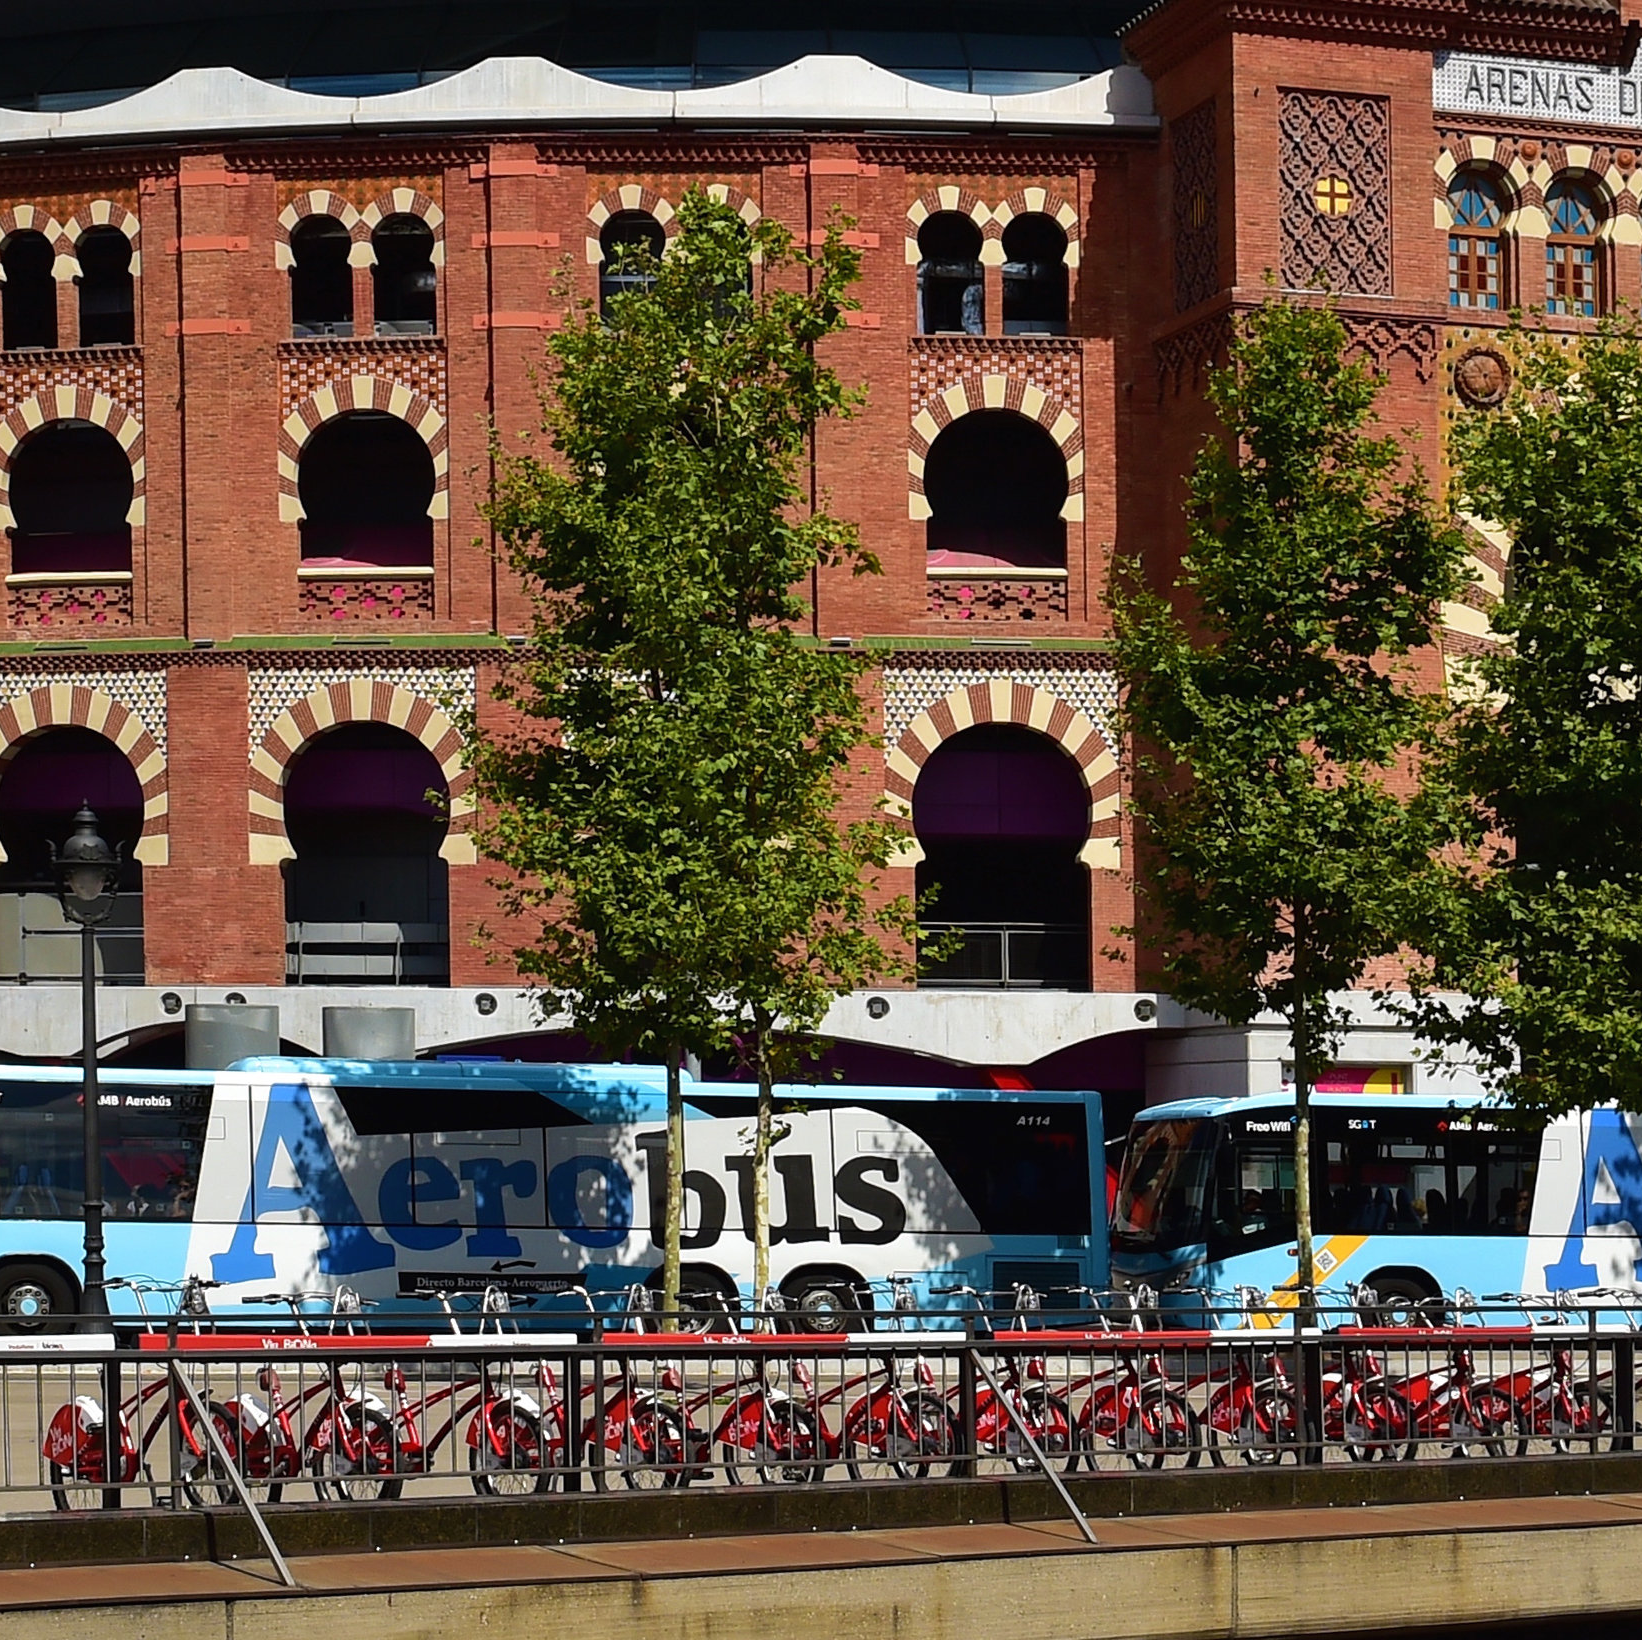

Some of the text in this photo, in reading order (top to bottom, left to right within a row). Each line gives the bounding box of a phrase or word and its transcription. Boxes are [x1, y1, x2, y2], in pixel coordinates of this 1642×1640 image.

[1463, 64, 1595, 113] ARENAS
[125, 1094, 172, 1108] Aerobús
[1016, 1115, 1050, 1126] A114
[1246, 1120, 1270, 1132] Free
[416, 1277, 455, 1287] Directo
